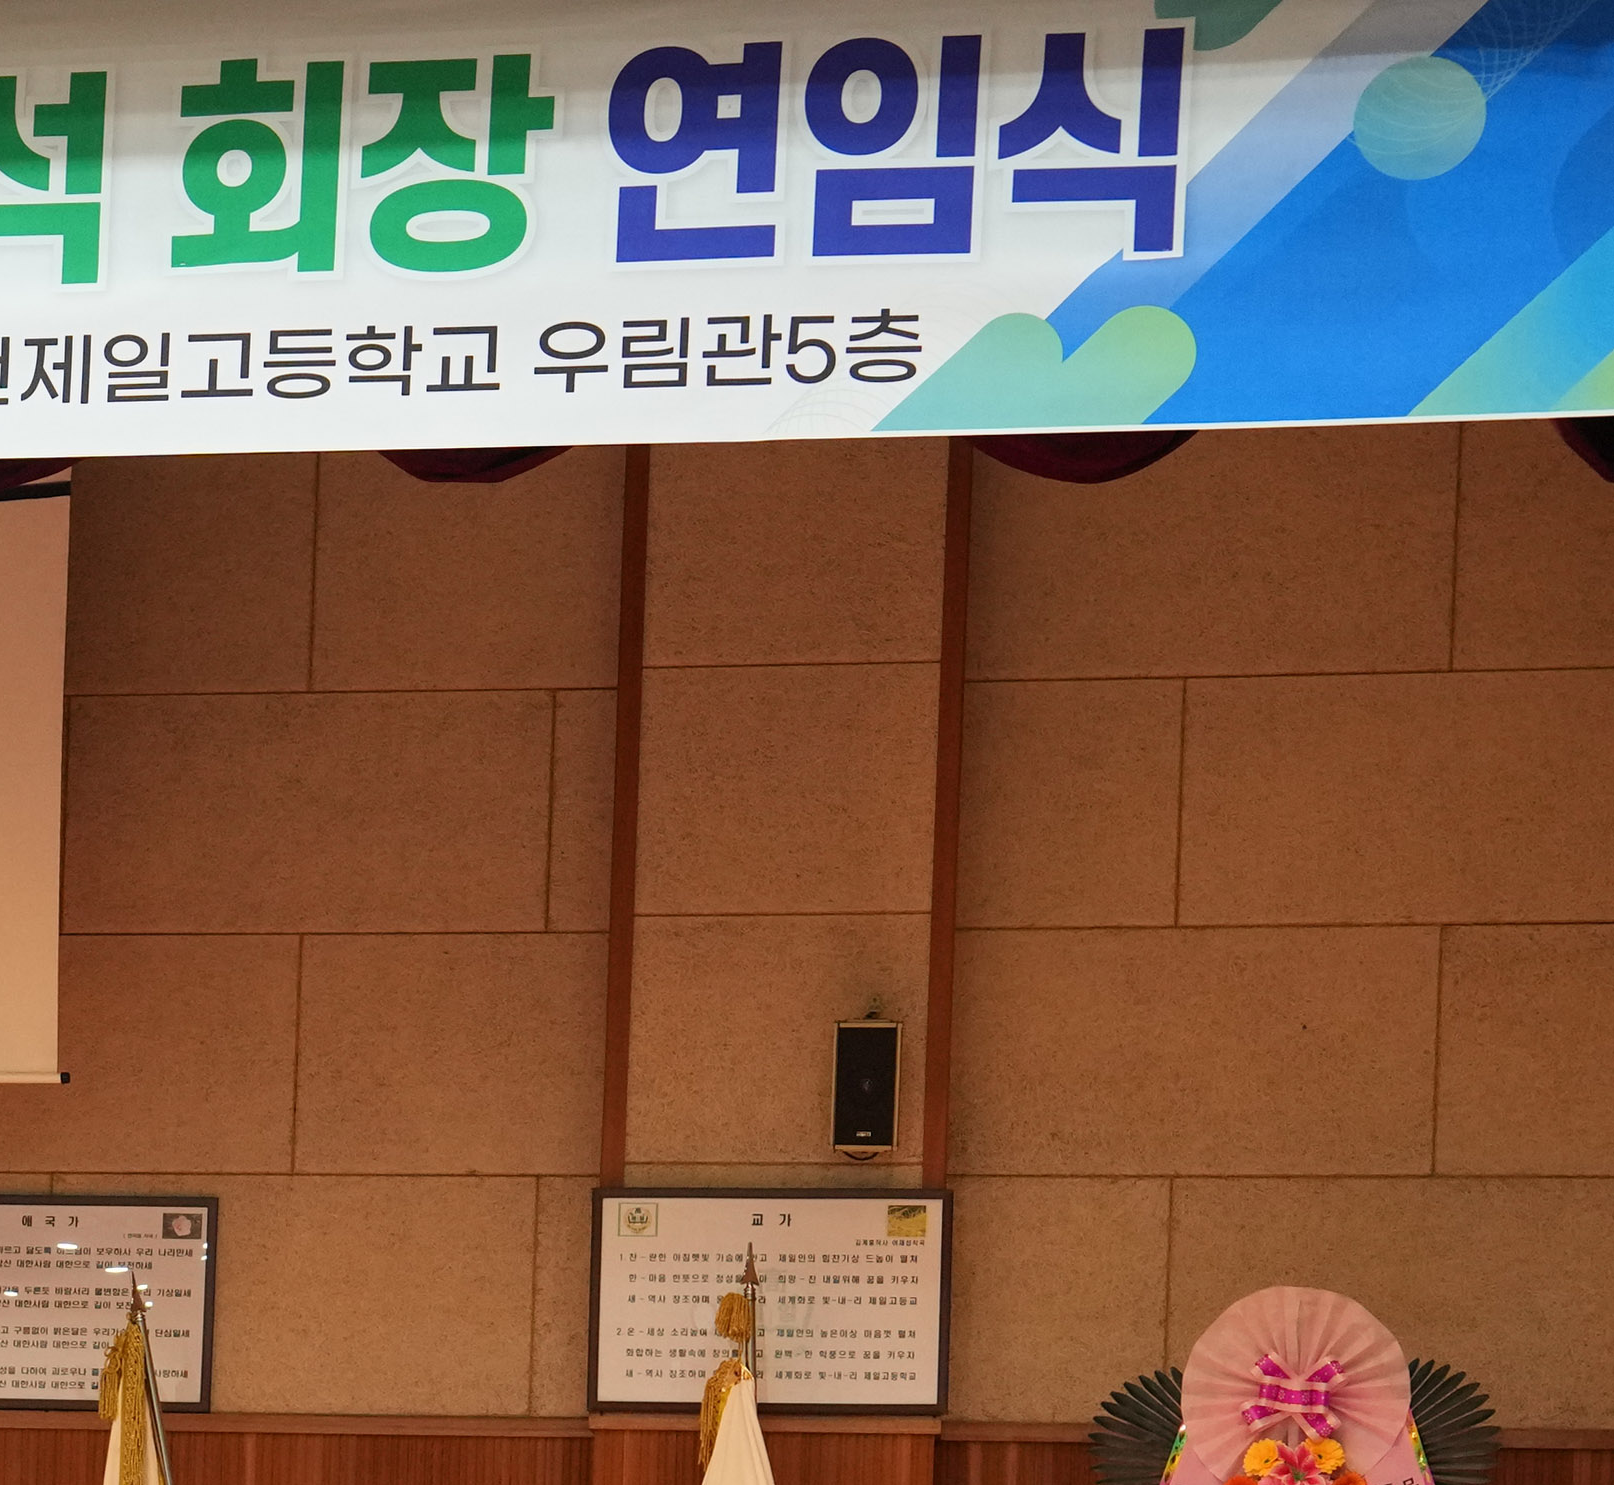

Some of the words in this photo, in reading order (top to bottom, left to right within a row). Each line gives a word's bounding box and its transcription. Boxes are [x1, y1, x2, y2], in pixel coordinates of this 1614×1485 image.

[172, 53, 555, 274] 회장
[608, 26, 1185, 263] 연임식
[534, 308, 924, 393] 우림관5층
[752, 1214, 763, 1225] 교
[780, 1214, 791, 1227] 가
